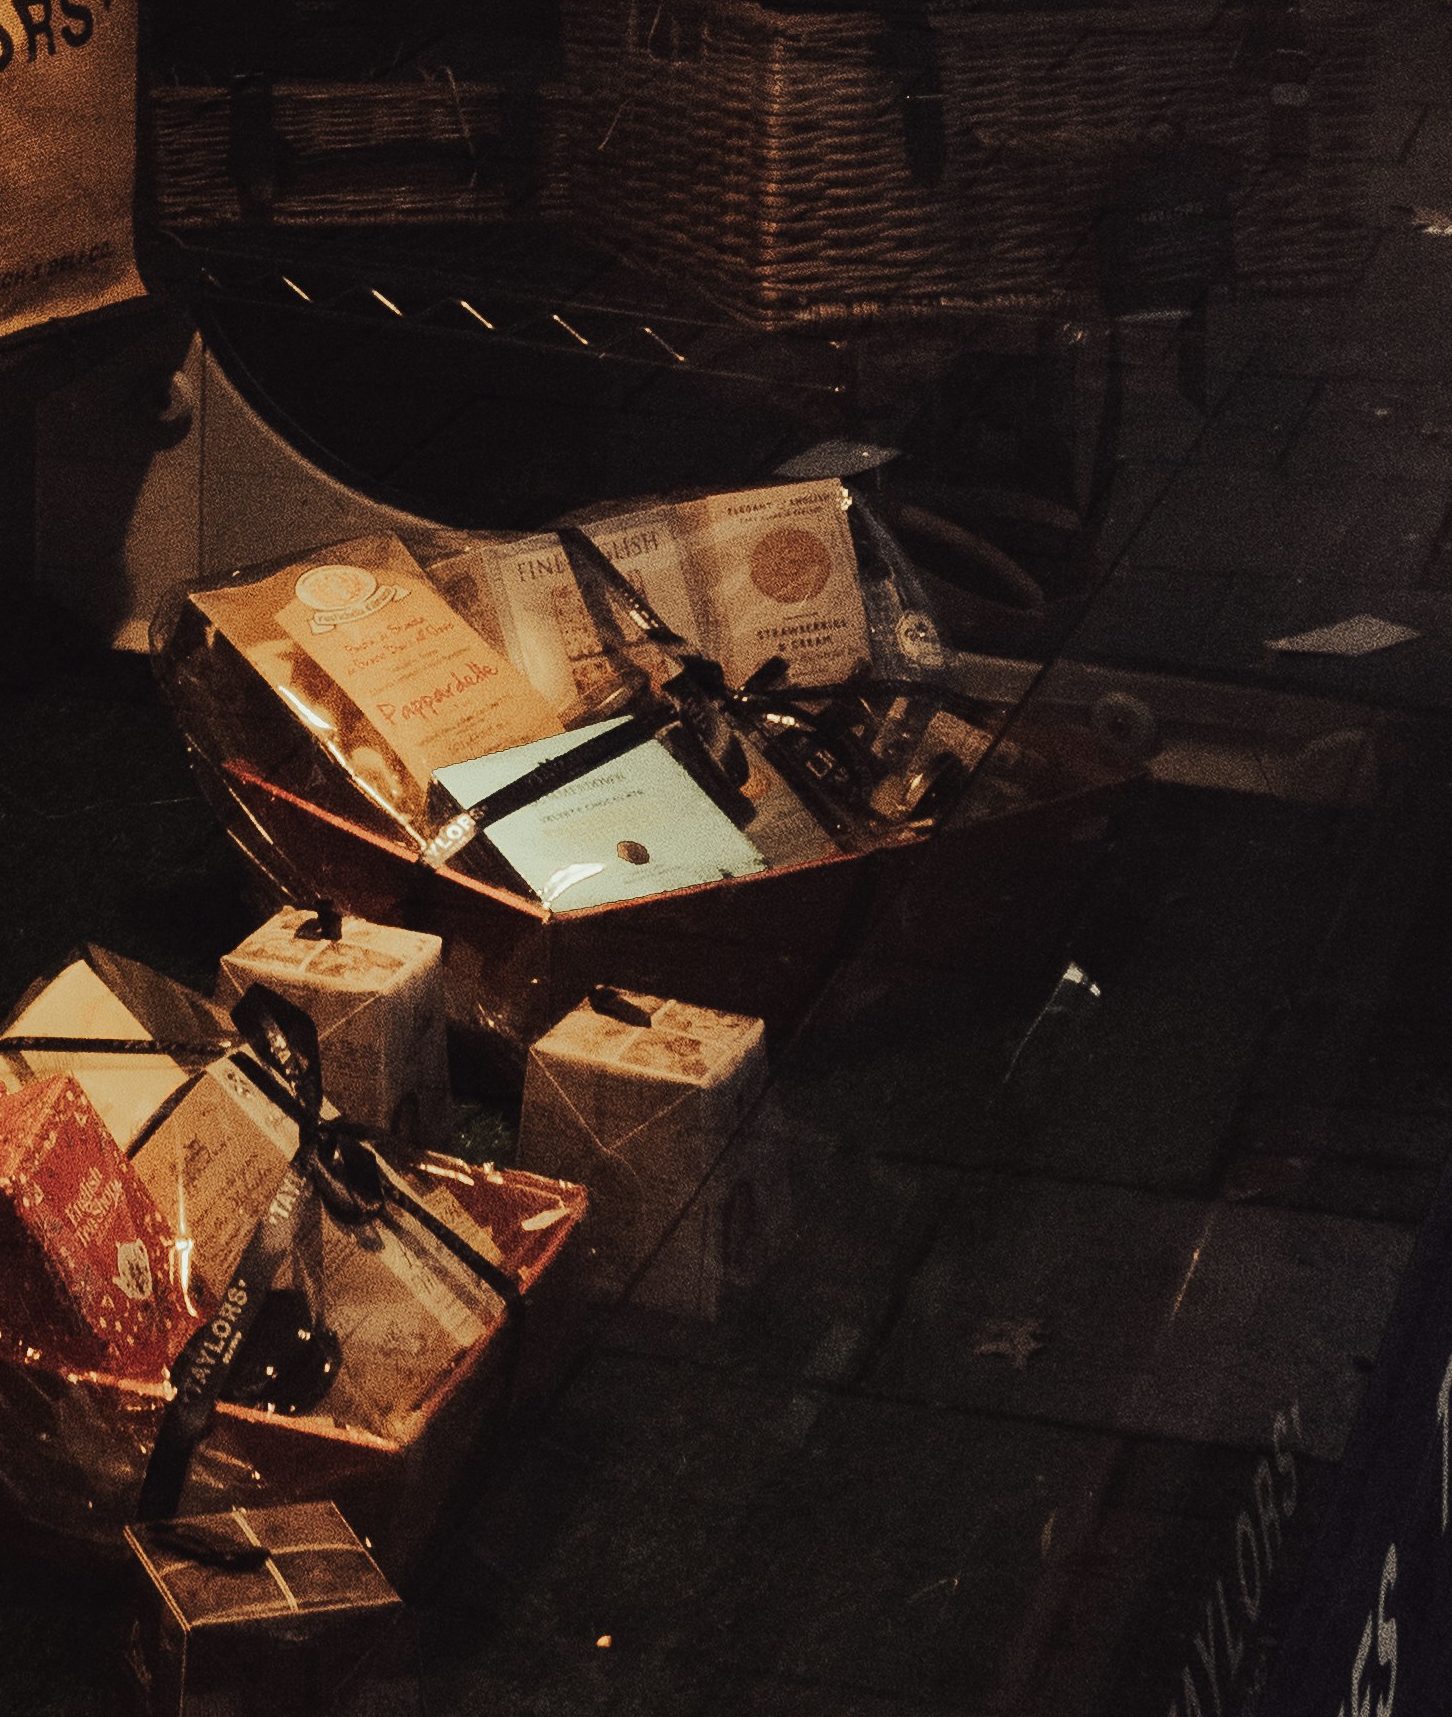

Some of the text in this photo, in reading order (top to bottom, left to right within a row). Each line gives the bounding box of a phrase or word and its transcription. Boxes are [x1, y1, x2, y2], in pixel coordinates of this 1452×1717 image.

[600, 529, 660, 563] GLISH
[376, 660, 499, 727] Pappardelle
[180, 1284, 250, 1393] TAYLORS
